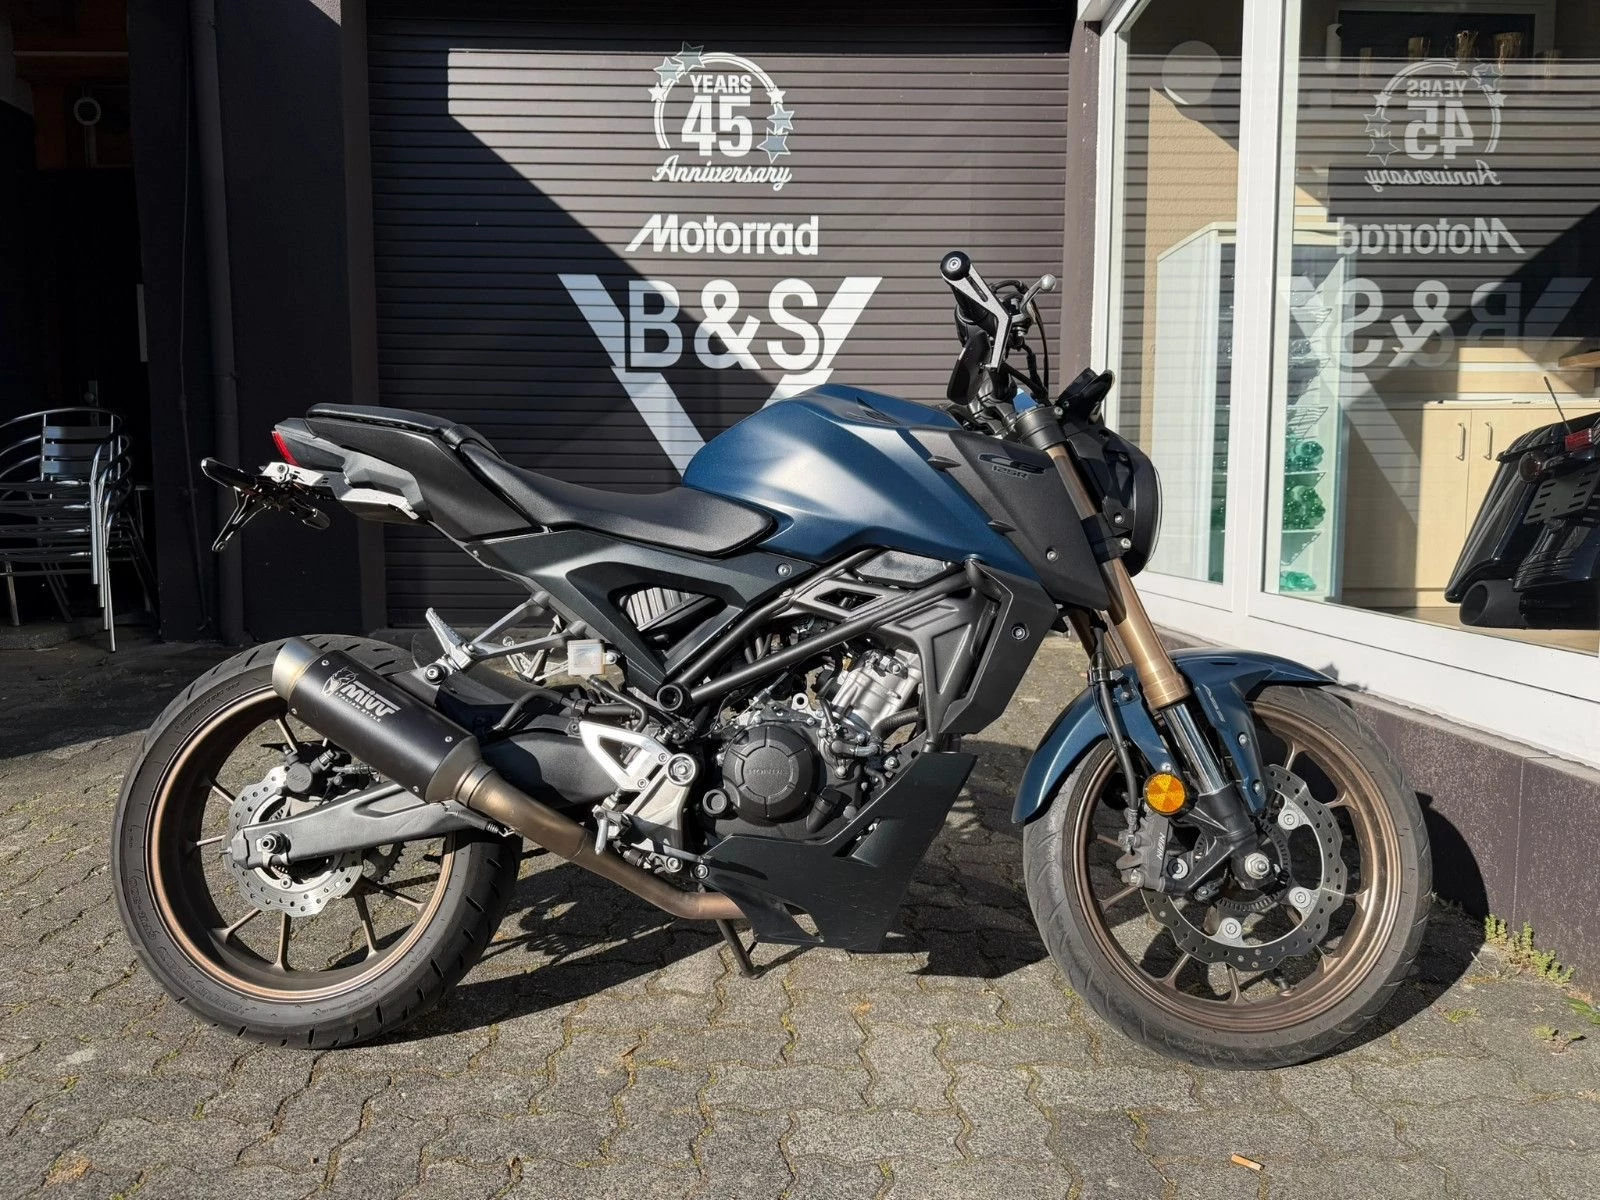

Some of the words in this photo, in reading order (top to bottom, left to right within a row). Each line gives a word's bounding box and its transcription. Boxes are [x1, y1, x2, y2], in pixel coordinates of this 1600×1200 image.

[690, 74, 752, 94] YEARS
[681, 95, 753, 157] 45
[652, 154, 793, 191] Anniversary
[625, 214, 819, 255] Motorrad
[628, 278, 820, 370] B&S
